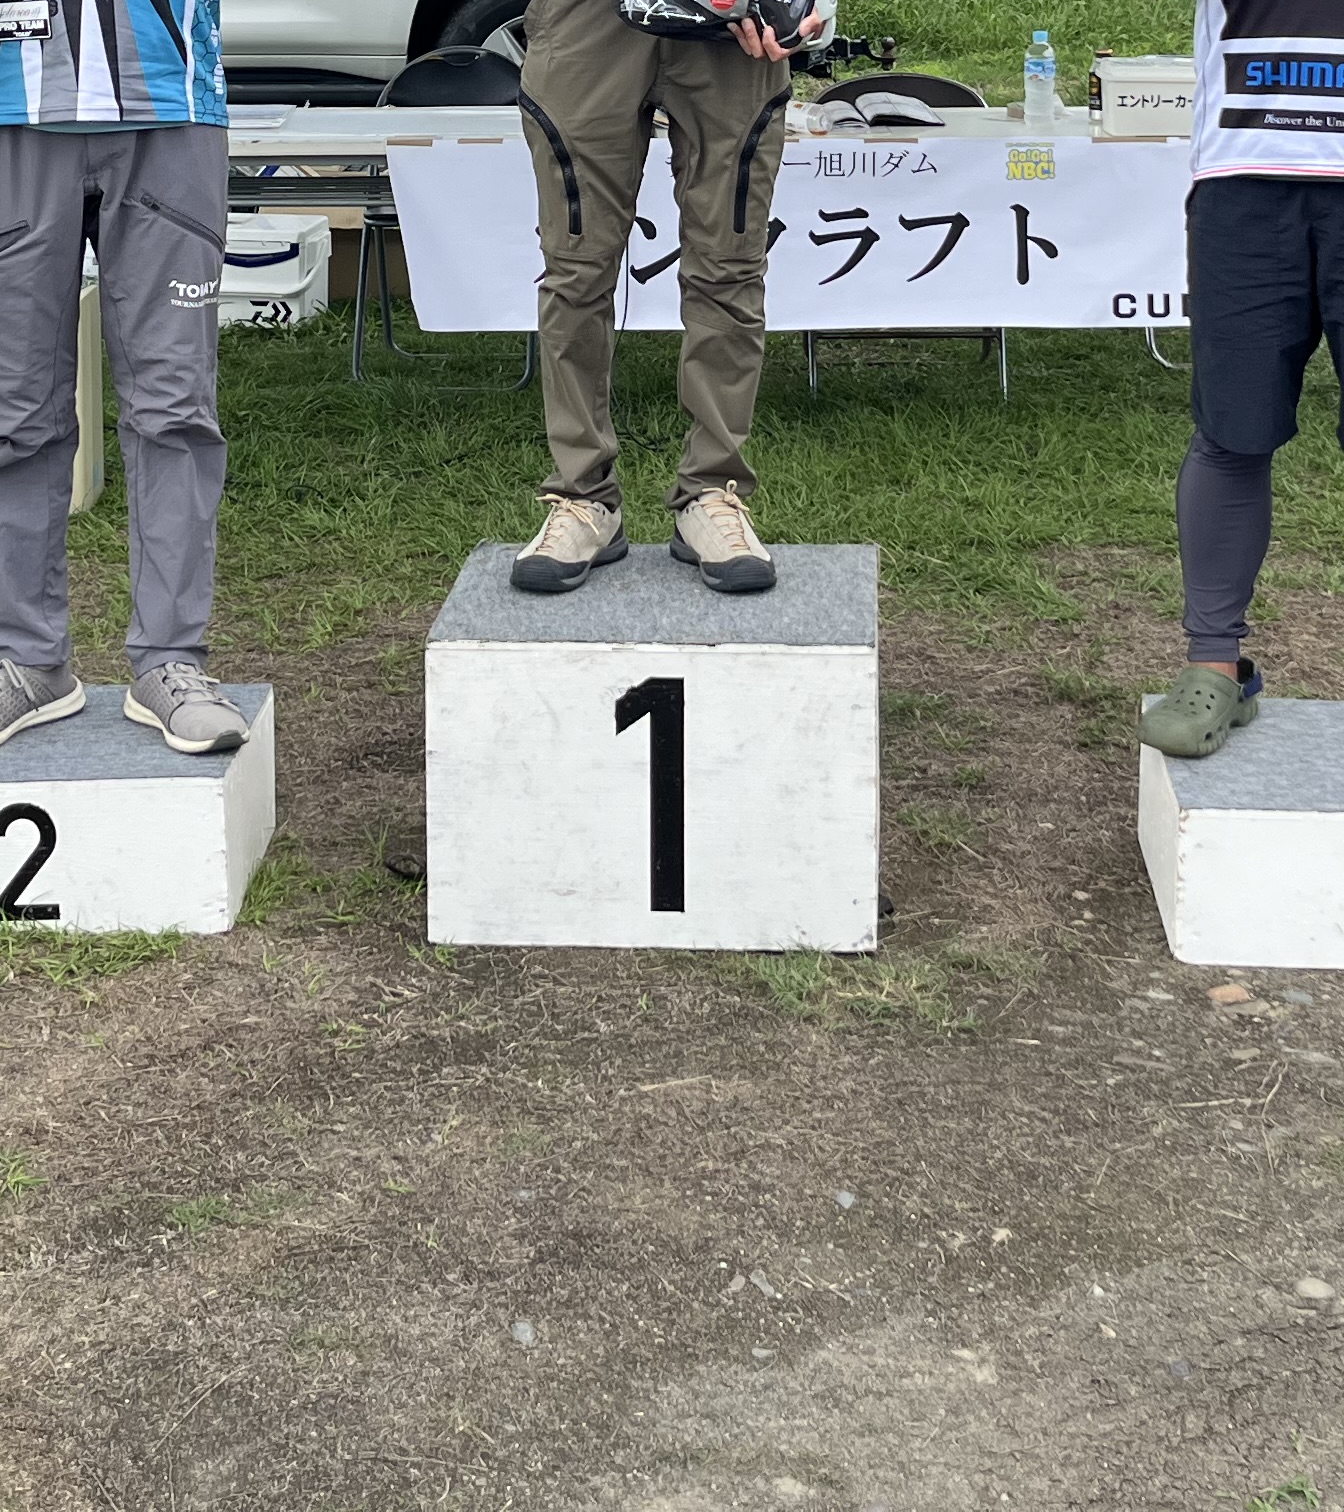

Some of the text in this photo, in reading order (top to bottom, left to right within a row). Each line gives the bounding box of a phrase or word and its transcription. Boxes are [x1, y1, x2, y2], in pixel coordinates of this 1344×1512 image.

[19, 19, 45, 30] TEAM
[1264, 113, 1303, 126] Discover
[1305, 115, 1324, 127] the
[1009, 149, 1053, 163] Go!Go!
[1006, 161, 1056, 180] NBC!
[1112, 293, 1192, 318] CU
[615, 676, 685, 913] 1
